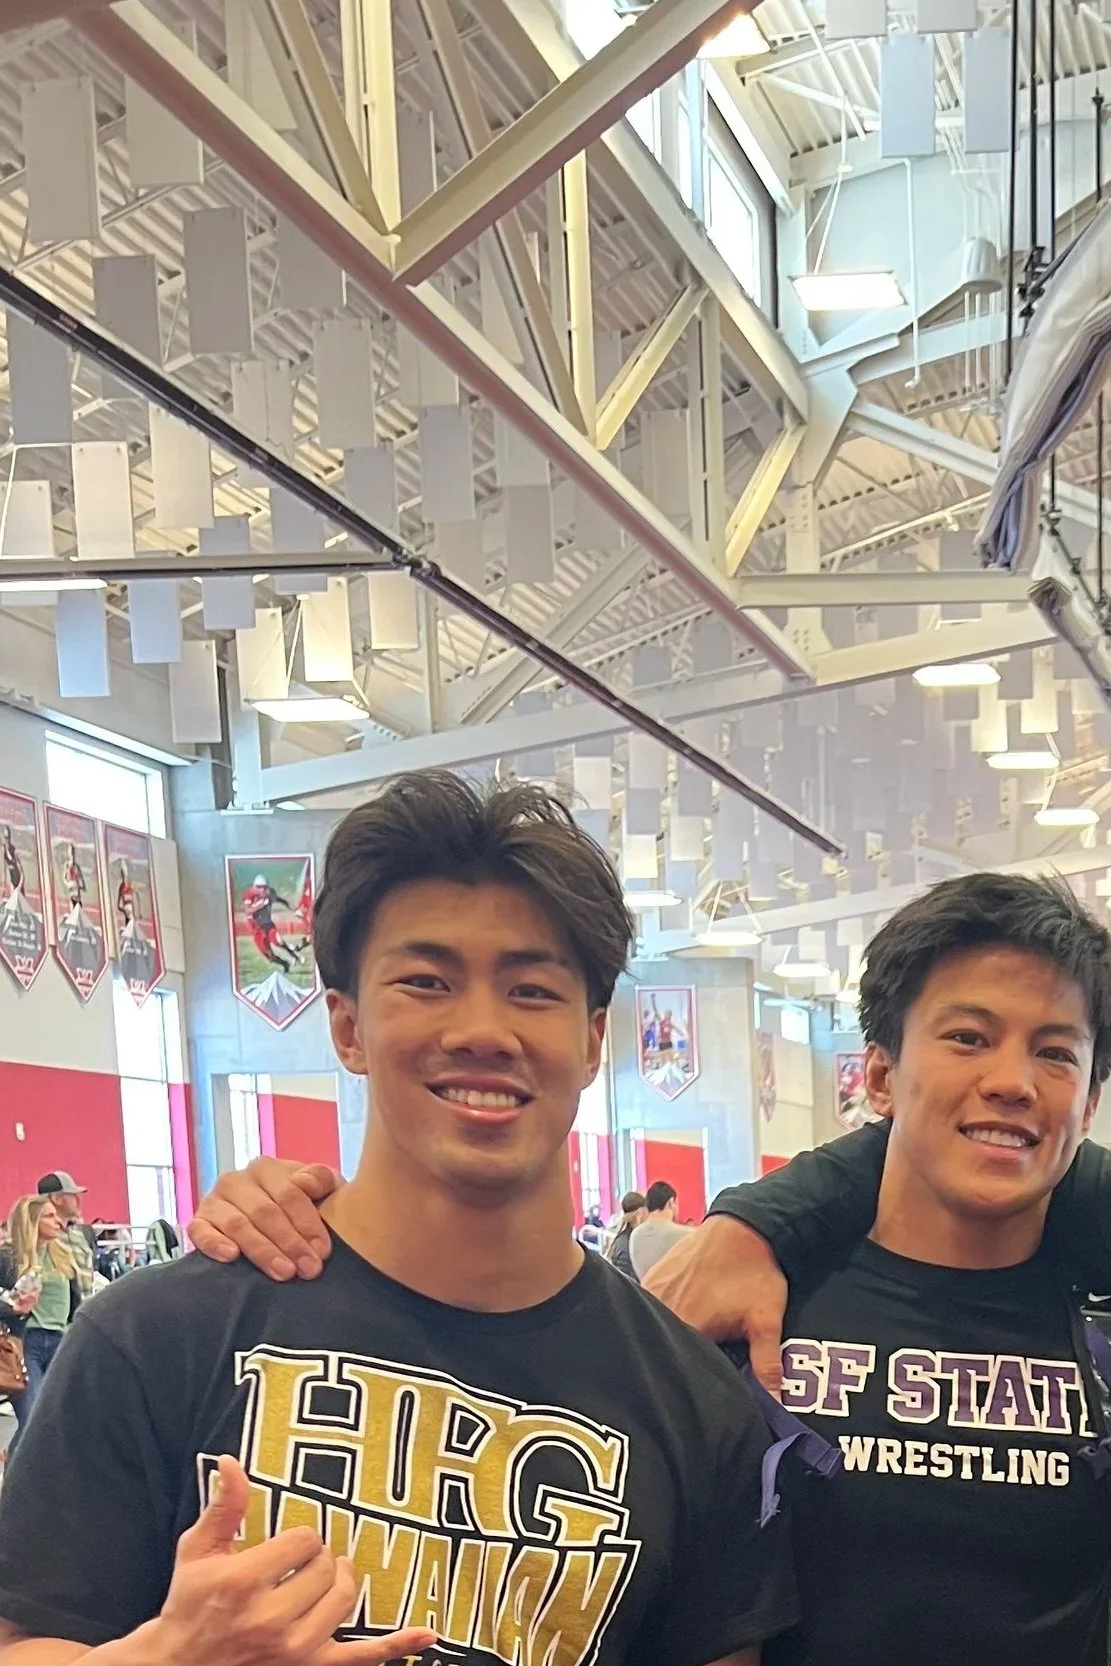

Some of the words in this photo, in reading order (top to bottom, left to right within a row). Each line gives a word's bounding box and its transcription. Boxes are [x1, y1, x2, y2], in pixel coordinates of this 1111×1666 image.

[780, 1337, 876, 1417] SF
[234, 1344, 631, 1548] HRG
[838, 1435, 1071, 1488] WRESTLING
